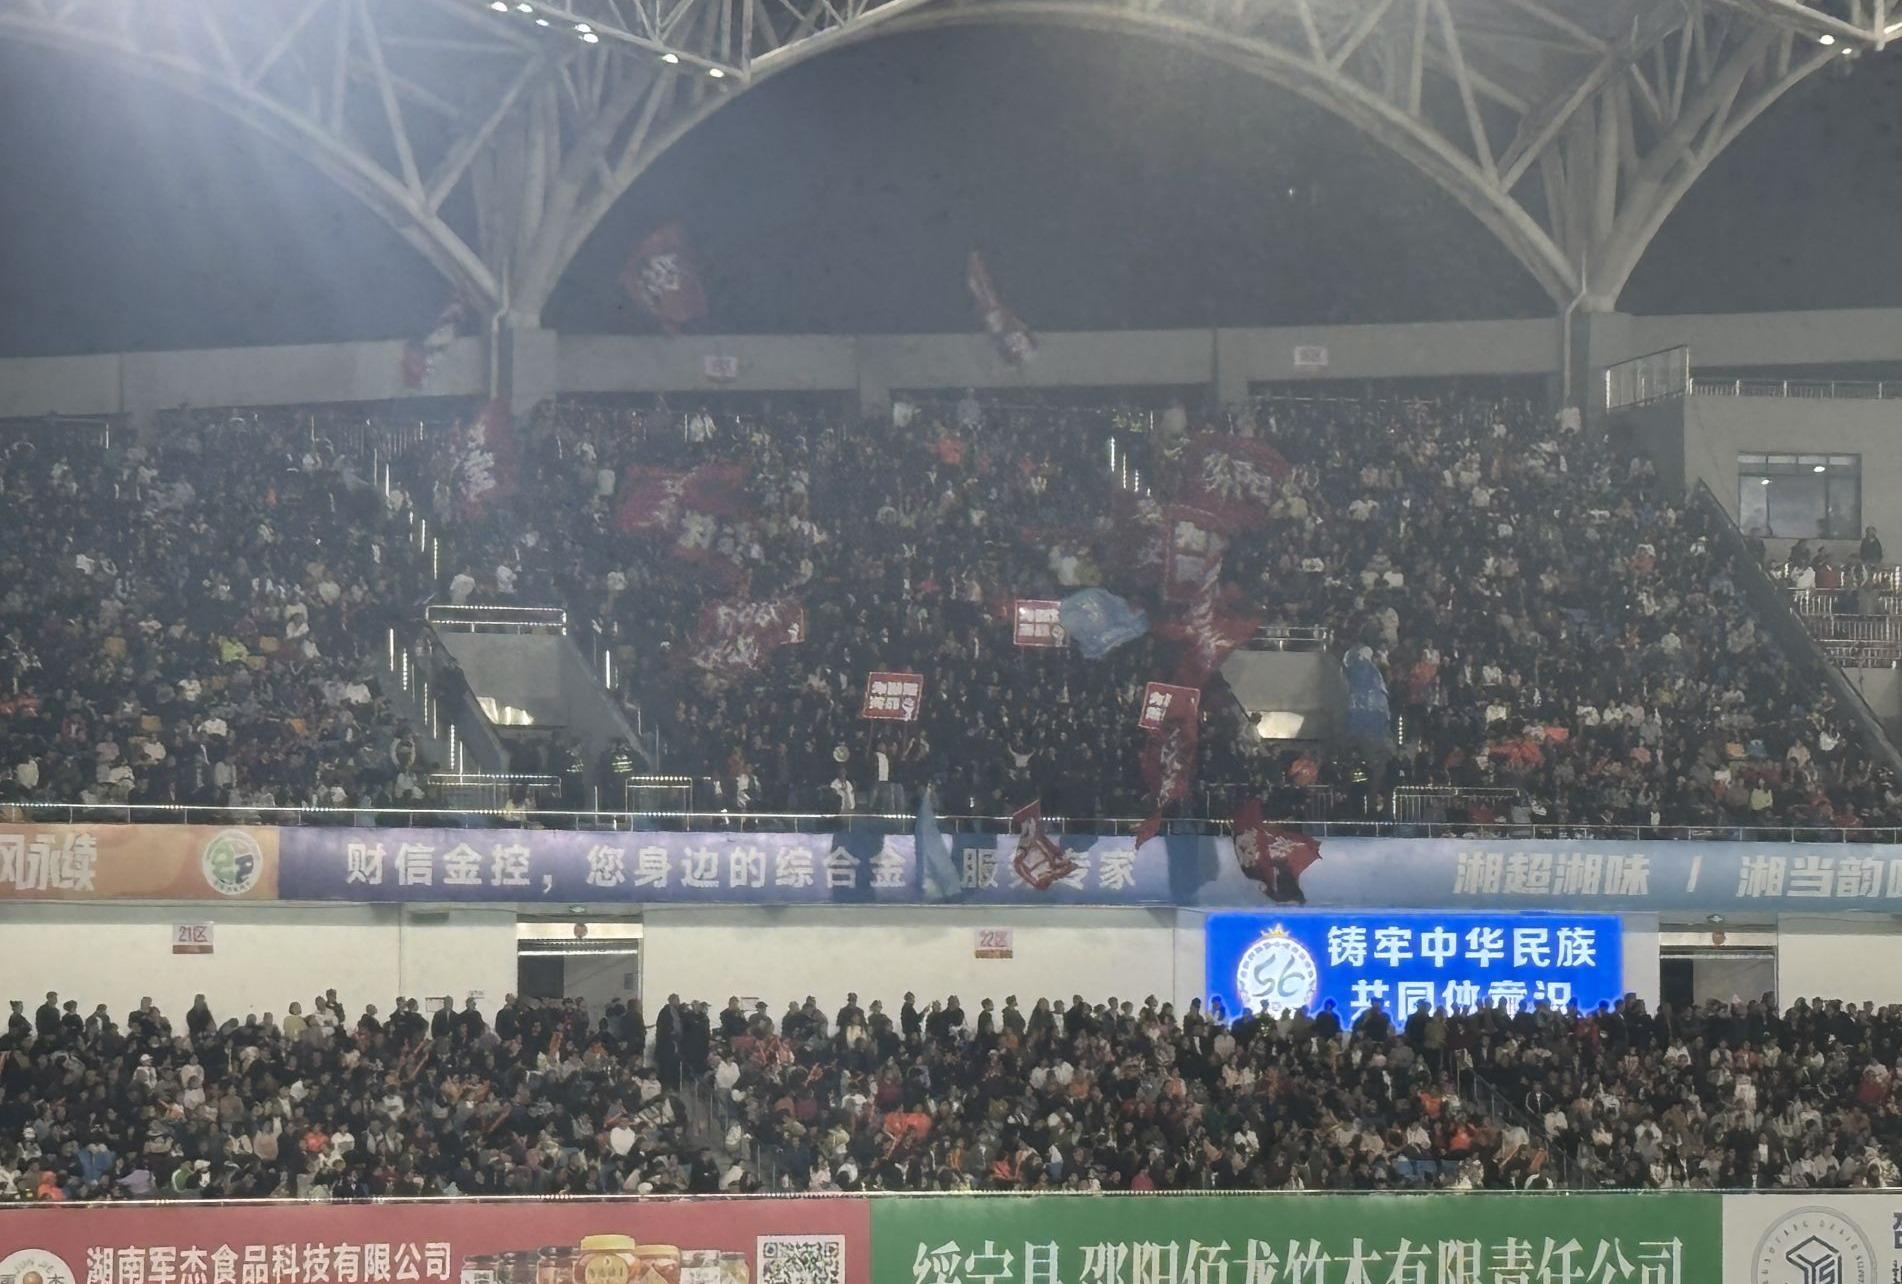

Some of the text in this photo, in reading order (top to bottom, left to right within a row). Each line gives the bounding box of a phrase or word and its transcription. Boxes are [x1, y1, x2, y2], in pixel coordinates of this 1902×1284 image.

[1452, 852, 1650, 896] 湘超湘味
[178, 925, 209, 942] 21区
[1327, 926, 1597, 968] 铸牢中华民族
[1251, 953, 1306, 998] 56
[86, 1242, 452, 1284] 湖南军杰食品科技有限公司
